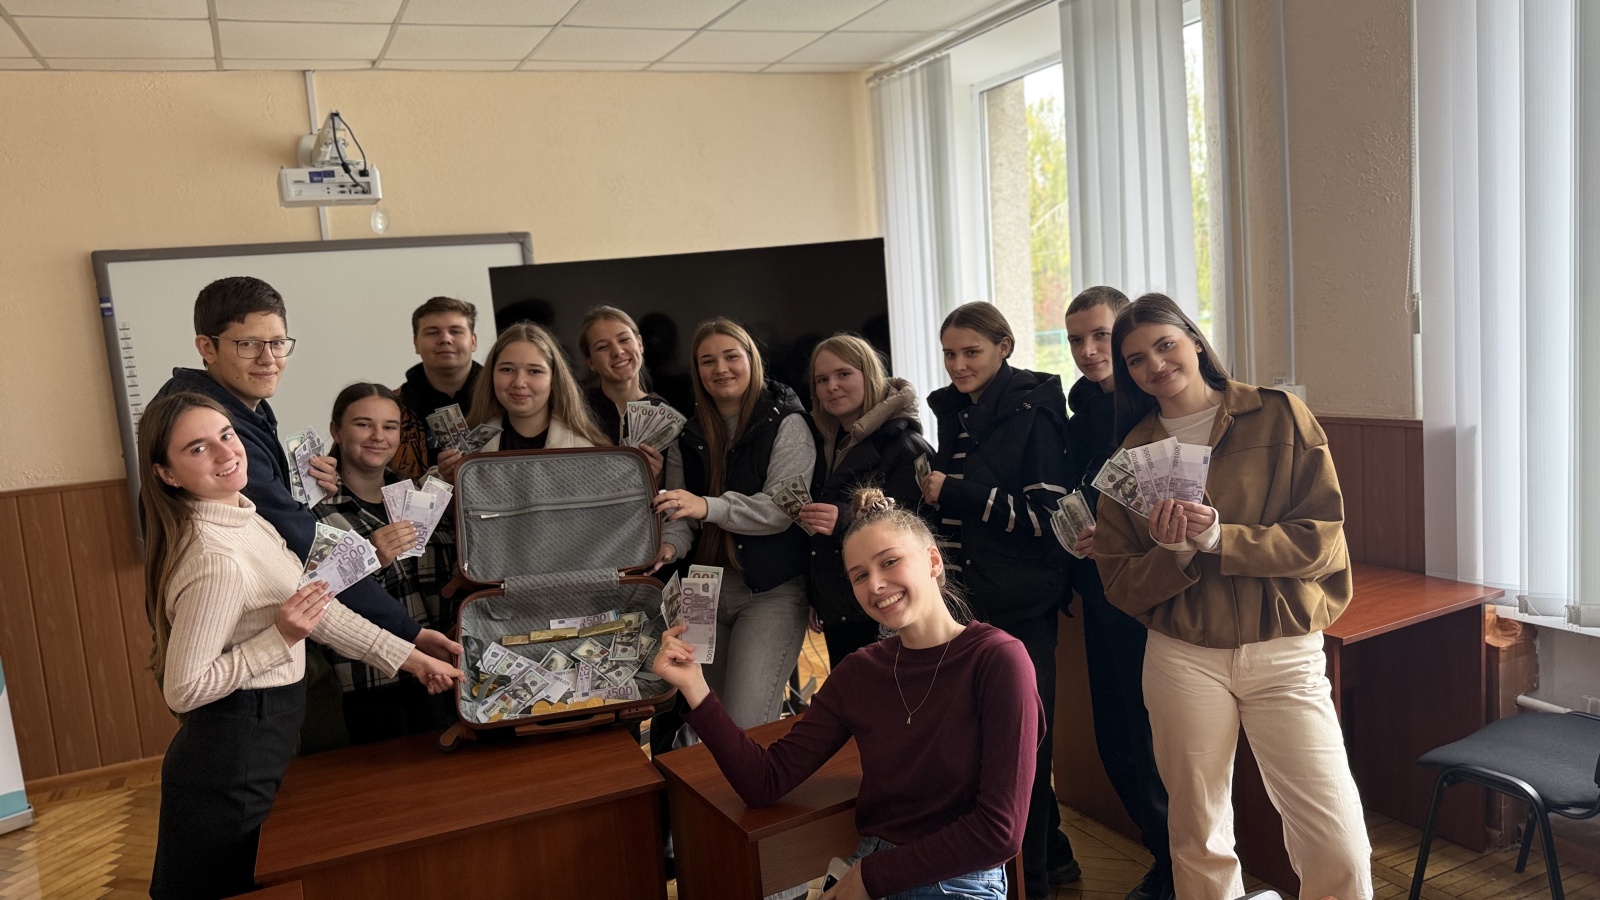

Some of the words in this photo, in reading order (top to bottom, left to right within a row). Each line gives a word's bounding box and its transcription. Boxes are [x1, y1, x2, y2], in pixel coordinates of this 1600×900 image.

[331, 536, 355, 559] 500
[415, 531, 428, 551] 500
[342, 544, 366, 564] 500
[682, 587, 694, 615] 500
[585, 613, 607, 625] 500
[611, 685, 633, 698] 500
